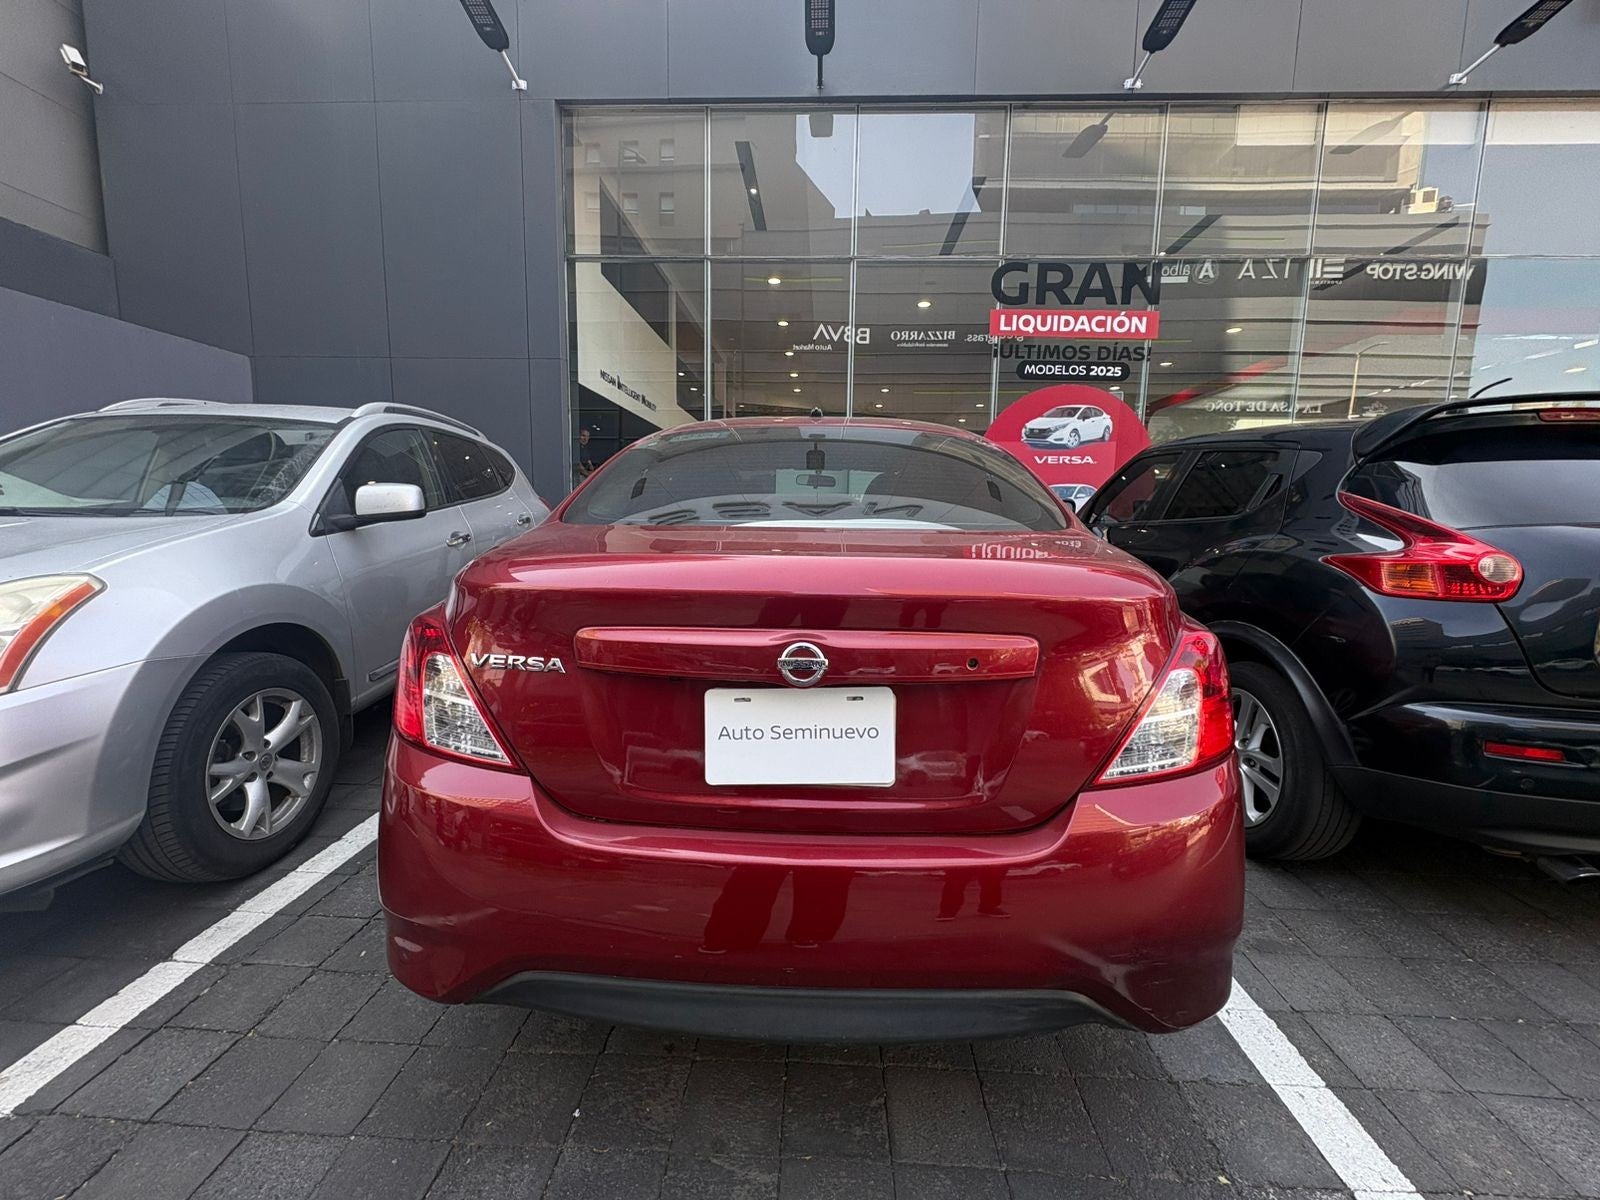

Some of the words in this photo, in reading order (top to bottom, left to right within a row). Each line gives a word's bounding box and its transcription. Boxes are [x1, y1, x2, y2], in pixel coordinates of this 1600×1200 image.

[991, 262, 1163, 305] GRAN
[999, 312, 1148, 333] LIQUIDACIÓN
[1097, 342, 1152, 361] DÍAS!
[1024, 364, 1087, 375] MODELOS
[1089, 365, 1122, 377] 2025
[1033, 455, 1095, 465] VERSA
[470, 653, 567, 674] VERSA
[780, 659, 826, 669] NISSAN
[718, 725, 765, 741] Auto
[770, 724, 880, 741] Seminuevo
